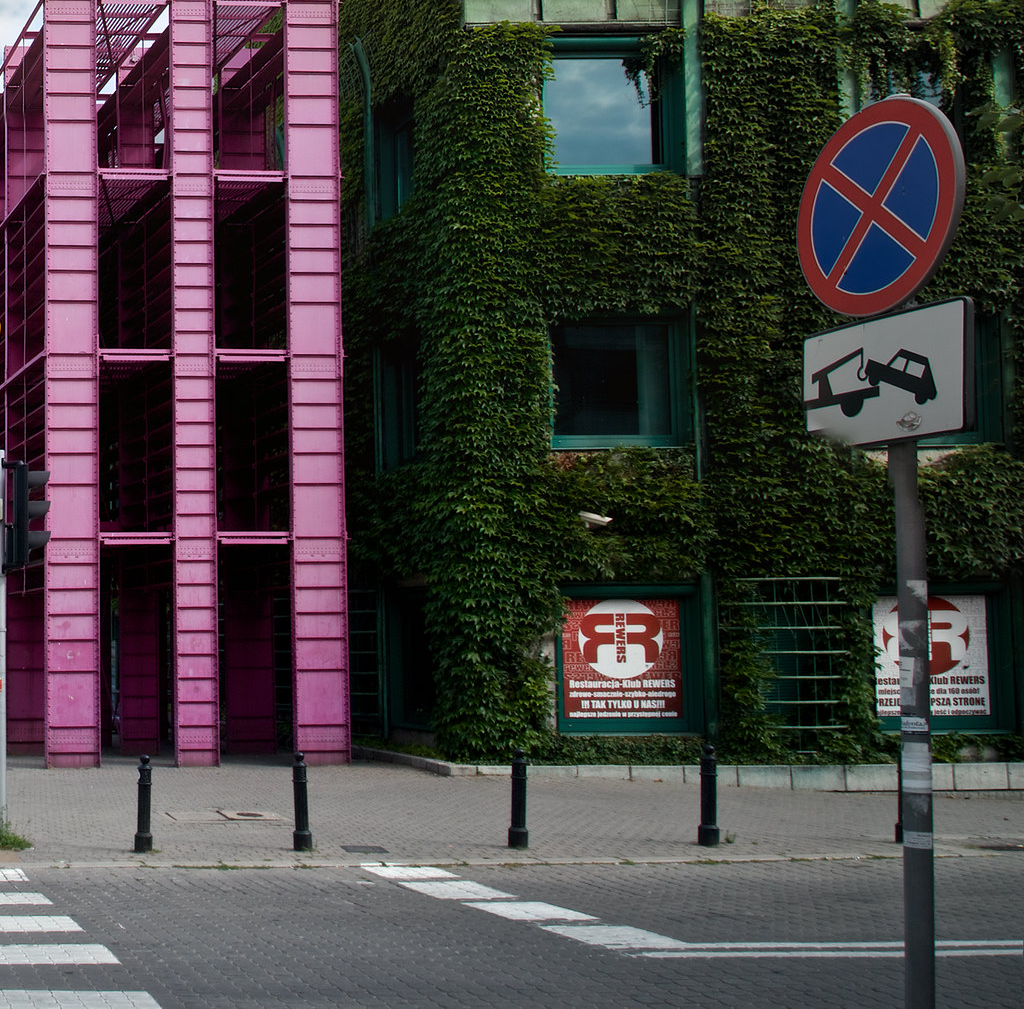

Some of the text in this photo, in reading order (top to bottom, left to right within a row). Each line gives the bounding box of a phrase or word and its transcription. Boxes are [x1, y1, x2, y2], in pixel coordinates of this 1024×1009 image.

[615, 613, 627, 663] REWERS
[569, 679, 676, 689] Restauracja-Klub REWERS
[950, 676, 985, 684] REWERS
[878, 688, 900, 696] miejsc
[591, 700, 606, 708] TAK
[607, 700, 632, 708] TYLKO
[633, 700, 640, 708] U
[640, 700, 665, 708] NAS!!!
[930, 697, 951, 706] PSZĄ
